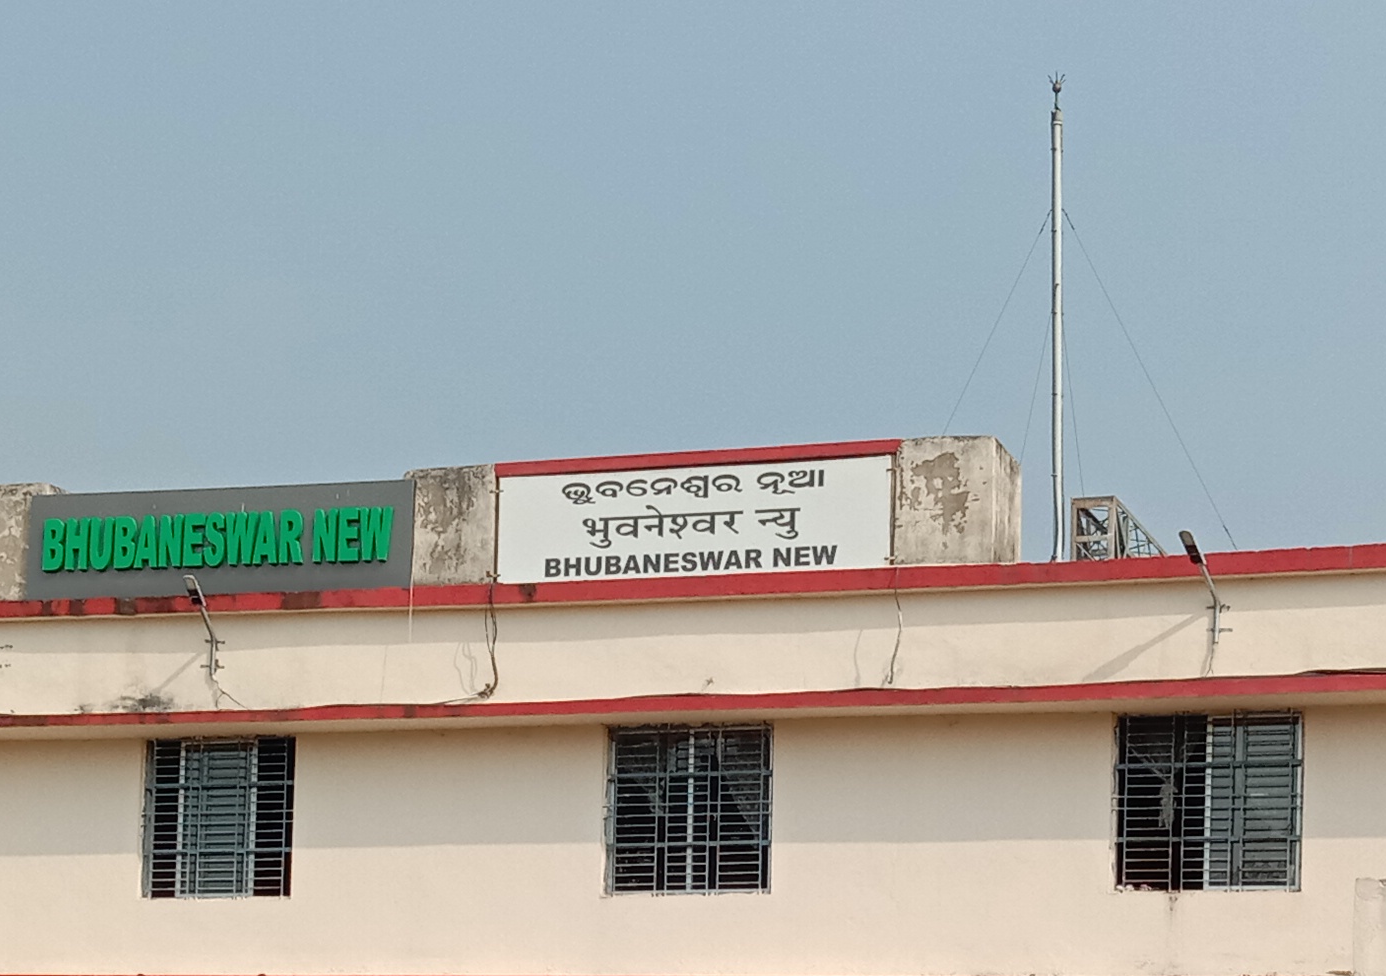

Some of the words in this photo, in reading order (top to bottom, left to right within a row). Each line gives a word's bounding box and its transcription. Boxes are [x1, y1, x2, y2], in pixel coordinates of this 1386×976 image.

[756, 468, 825, 494] ନୂଆ
[41, 508, 304, 573] BHUBANESWAR
[311, 505, 395, 564] NEW
[581, 504, 744, 549] भुवनेश्वर
[754, 506, 801, 540] न्यु
[544, 548, 763, 578] BHUBANESWAR
[772, 544, 839, 568] NEW
